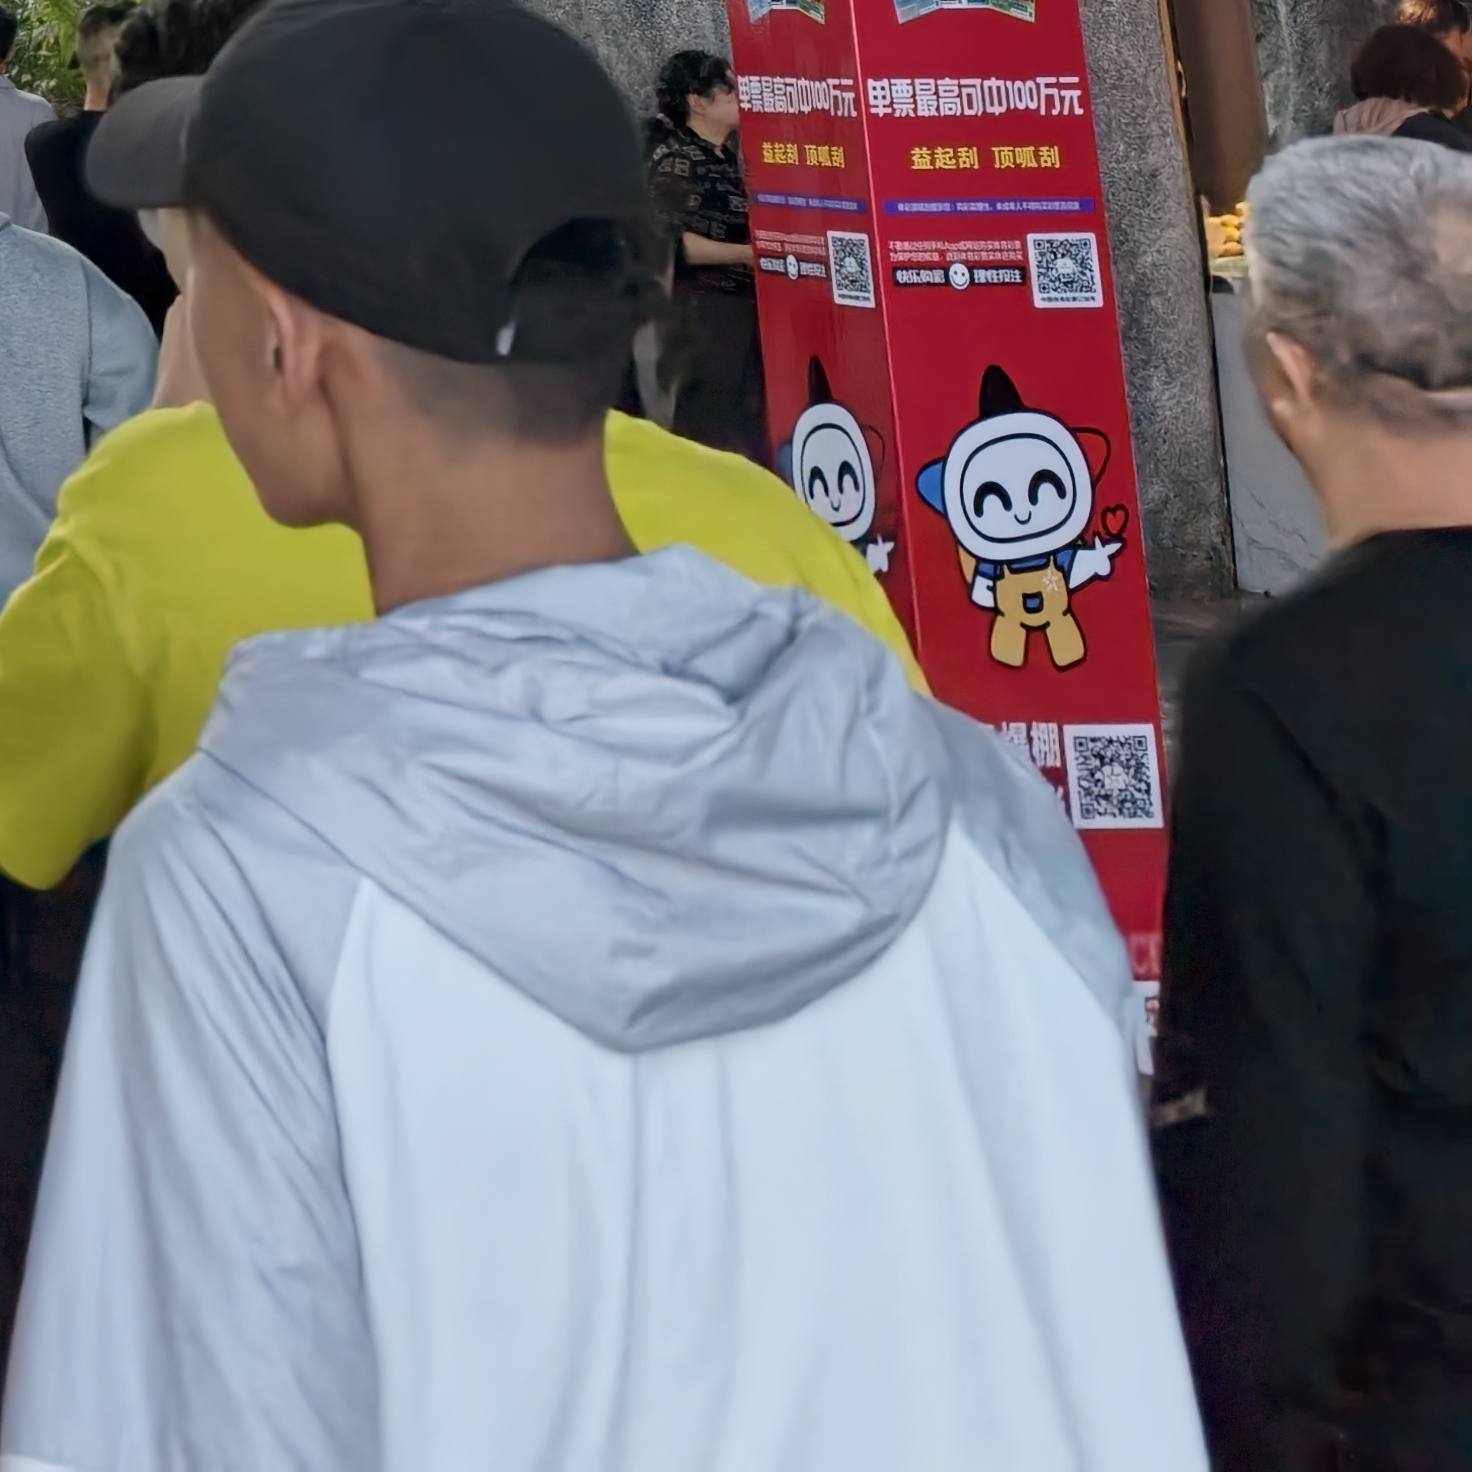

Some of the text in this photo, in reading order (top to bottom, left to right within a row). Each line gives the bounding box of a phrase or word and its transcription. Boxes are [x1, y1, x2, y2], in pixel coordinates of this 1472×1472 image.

[737, 75, 857, 117] 单票最高可中100万元
[867, 76, 1084, 117] 单票最高可中100万元
[911, 146, 1060, 170] 益起刮 顶呱刮
[973, 269, 1024, 284] 理性投注
